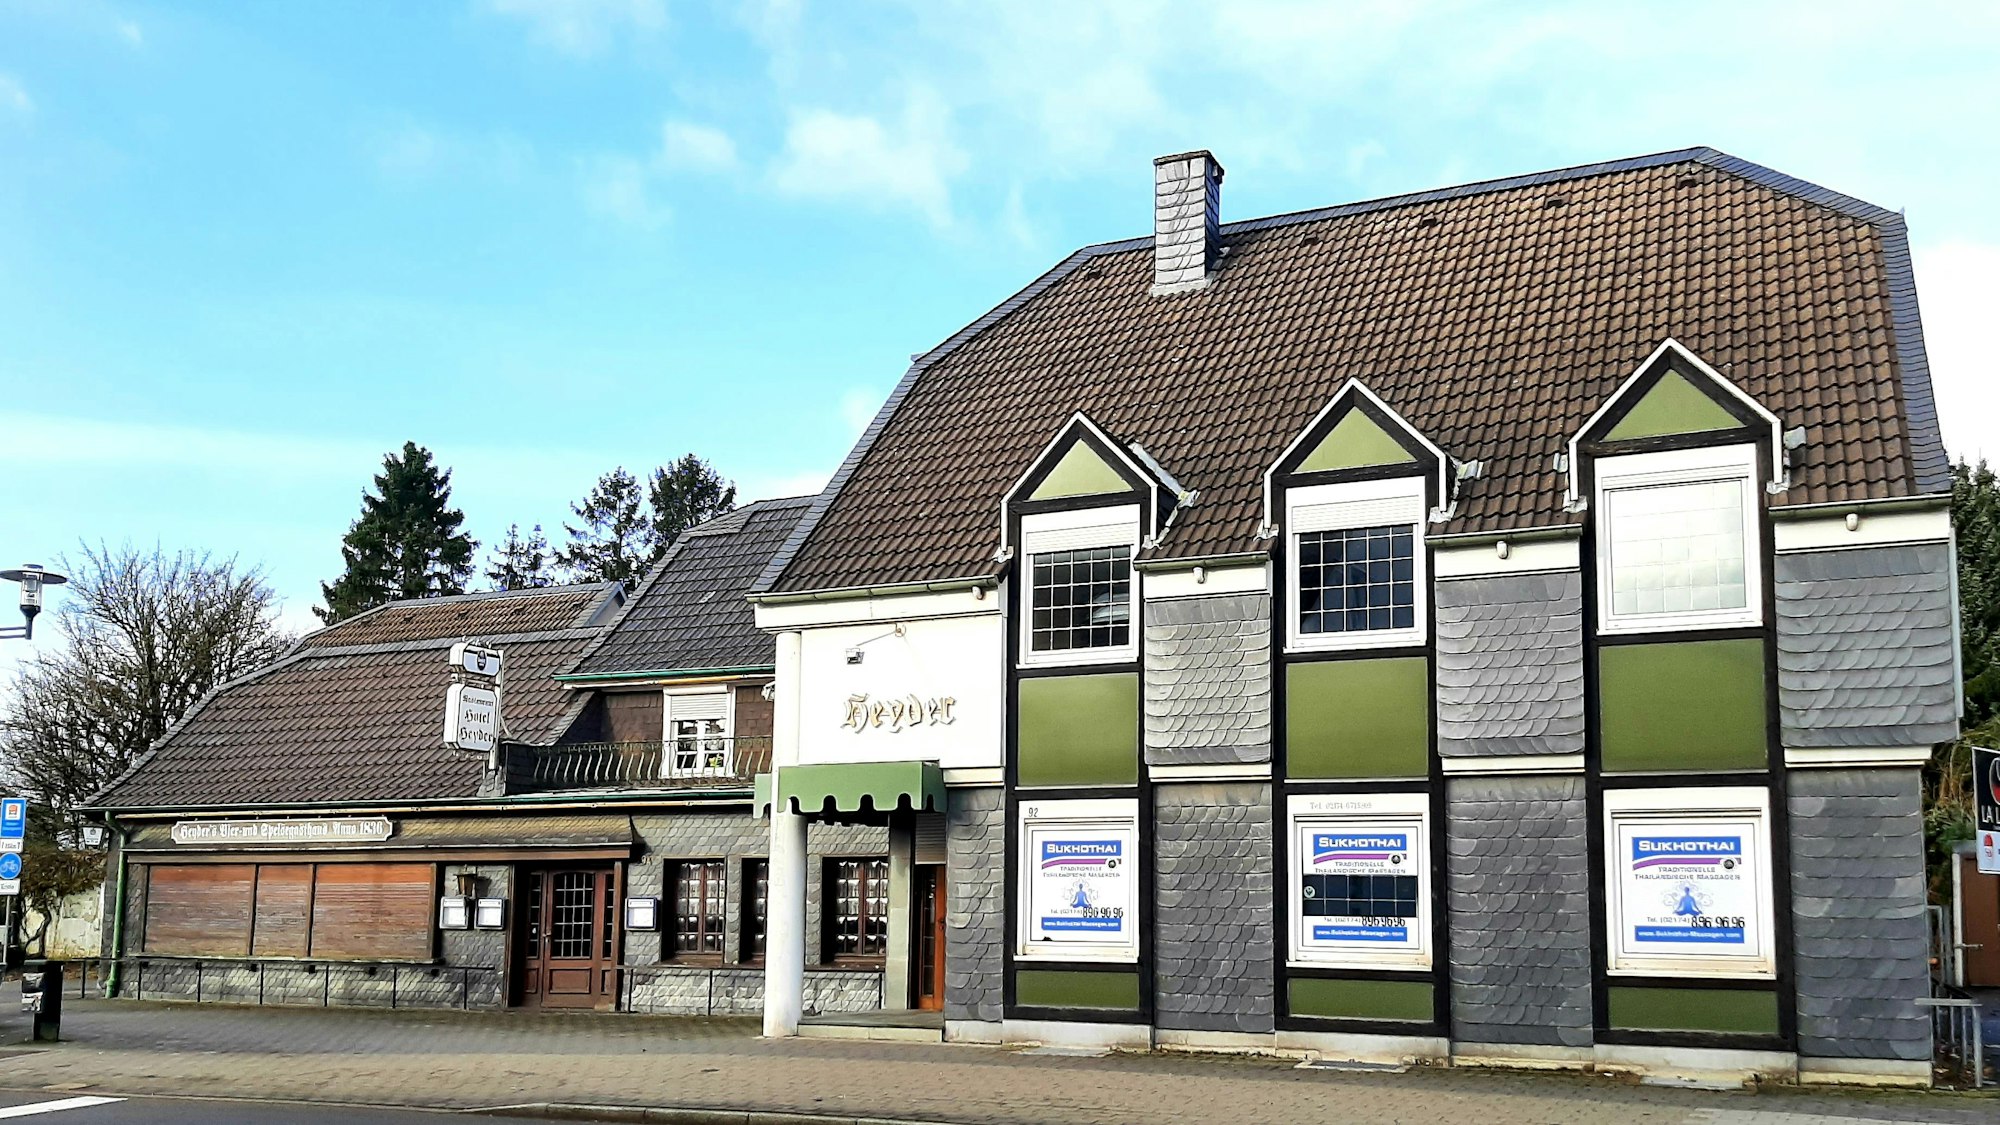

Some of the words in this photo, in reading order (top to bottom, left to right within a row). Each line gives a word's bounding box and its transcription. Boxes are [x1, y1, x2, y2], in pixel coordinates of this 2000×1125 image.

[464, 709, 491, 724] Hotel
[840, 692, 957, 734] Heyder
[459, 727, 493, 744] Heyder
[1028, 807, 1039, 818] 92
[1981, 804, 1994, 823] LA
[179, 824, 217, 840] Heyder's
[332, 821, 357, 835] Anno
[1046, 843, 1117, 853] SUKHOTHAI
[1318, 837, 1401, 848] SUKHOTHAI
[1638, 840, 1735, 851] SUKHOTHAI
[1082, 906, 1099, 918] 896
[1100, 906, 1112, 918] 96
[1113, 906, 1124, 918] 96
[1361, 916, 1380, 927] 896
[1381, 916, 1393, 927] 96
[1394, 916, 1406, 927] 96
[1691, 915, 1712, 929] 896
[1715, 915, 1729, 929] 96
[1731, 915, 1745, 929] 96
